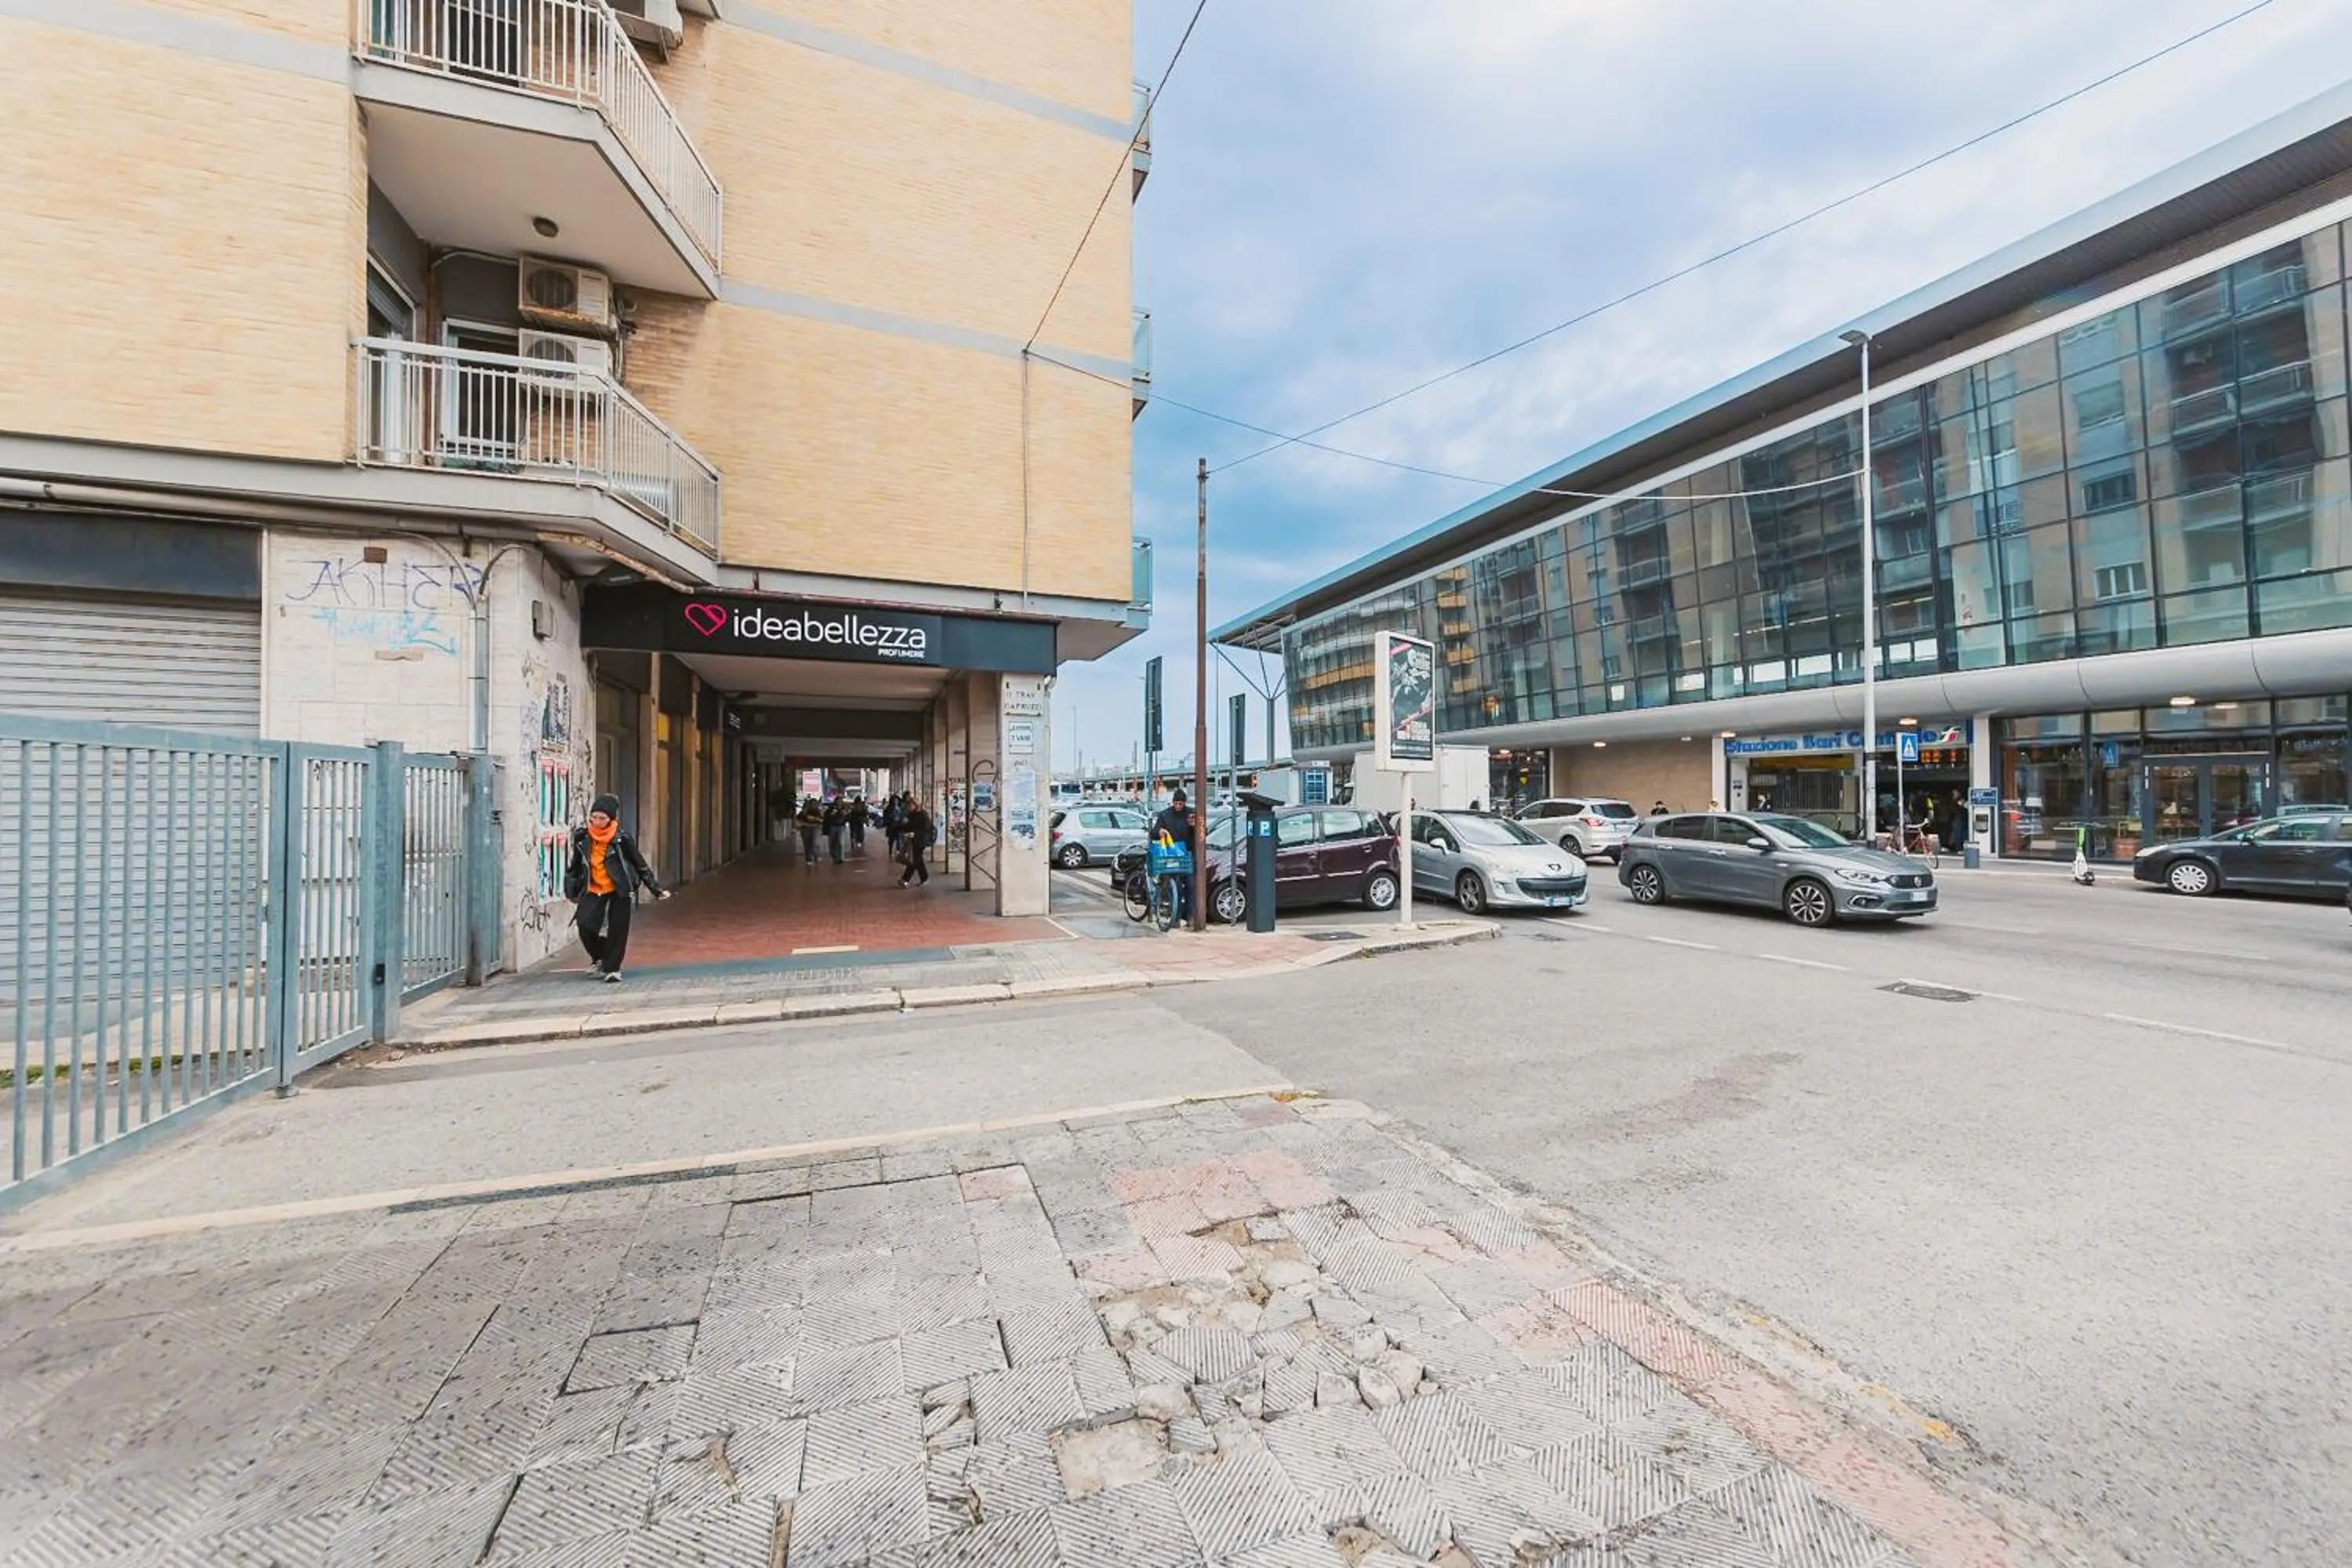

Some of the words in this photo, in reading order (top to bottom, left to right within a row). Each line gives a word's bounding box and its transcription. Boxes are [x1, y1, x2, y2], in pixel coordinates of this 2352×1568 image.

[733, 608, 927, 649] ideabellezza
[877, 648, 925, 659] PROFUMERIE
[1726, 739, 1798, 753] Stazione
[1802, 731, 1842, 750] Bari
